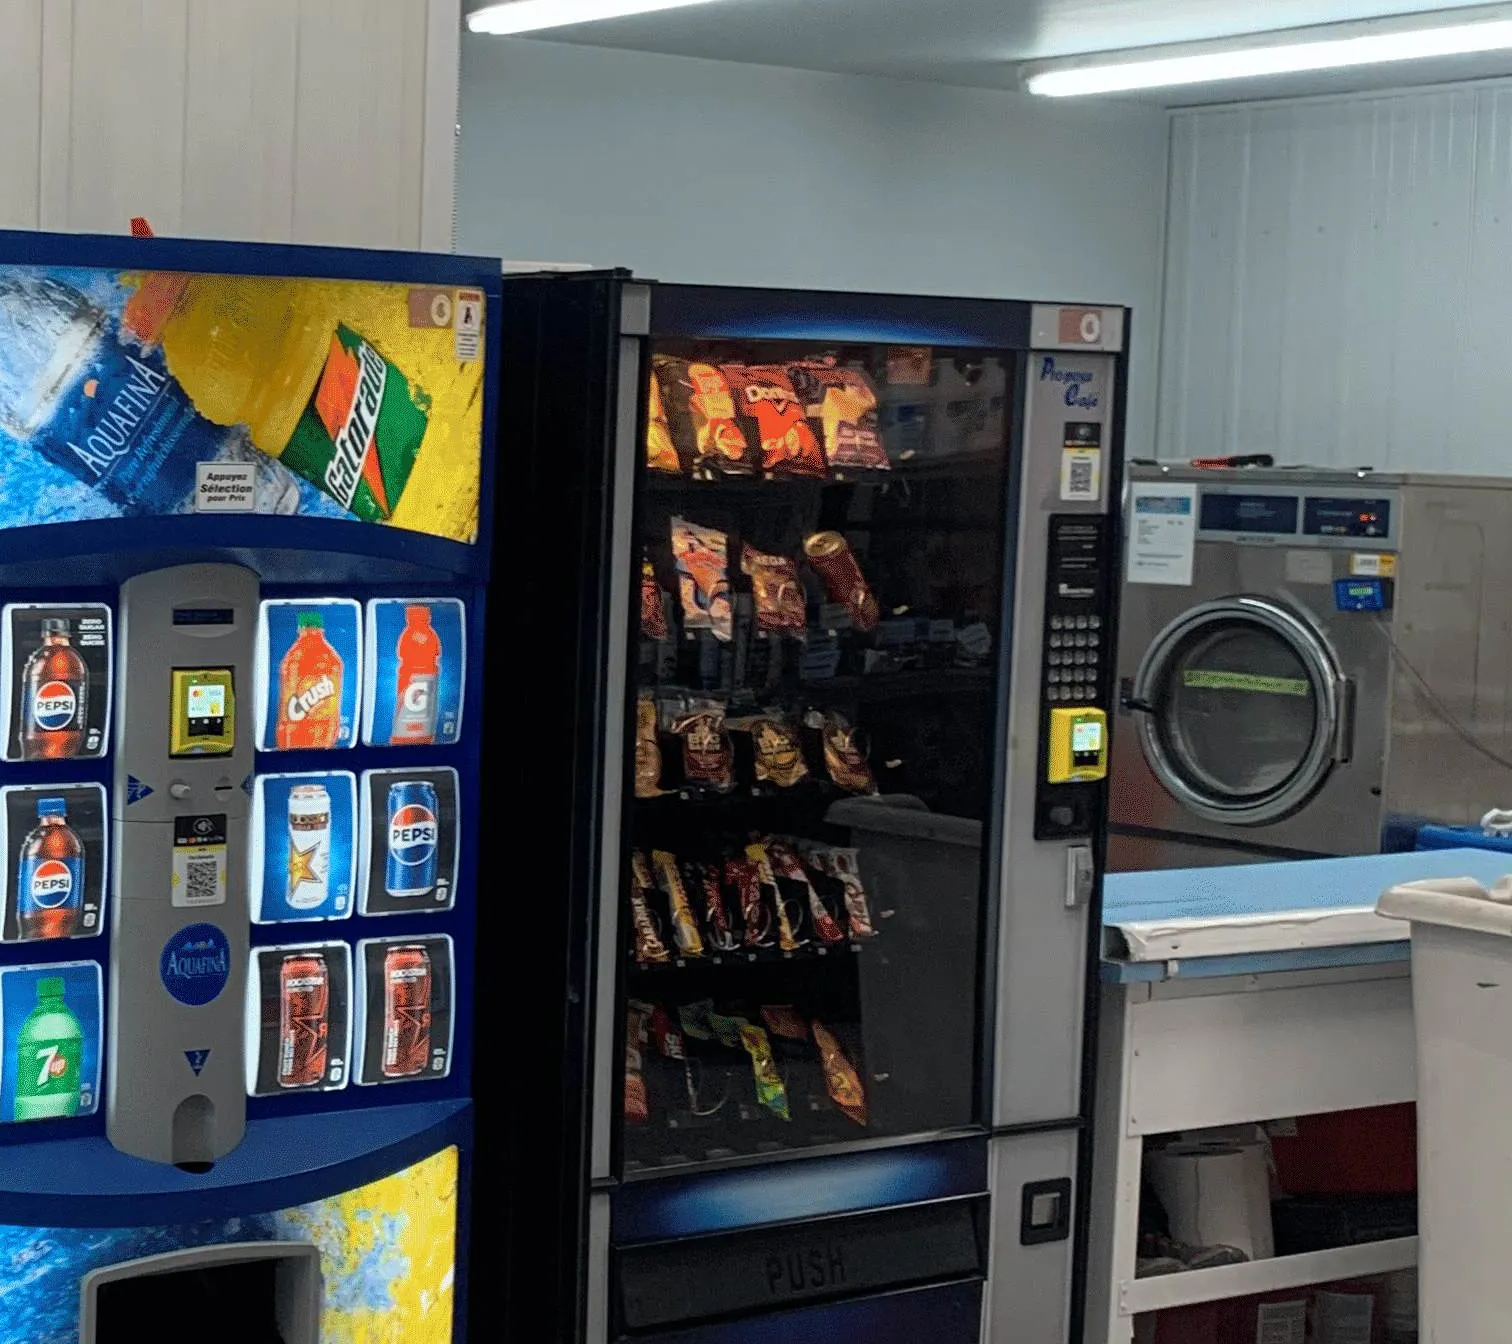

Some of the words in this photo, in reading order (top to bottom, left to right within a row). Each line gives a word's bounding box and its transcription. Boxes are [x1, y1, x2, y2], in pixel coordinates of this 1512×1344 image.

[66, 355, 165, 477] AQUAFINA
[326, 343, 386, 506] Gatorade
[200, 482, 252, 493] Sélection
[206, 472, 247, 482] Appuyez
[206, 495, 227, 503] pour
[229, 494, 245, 502] Prix
[38, 701, 73, 711] PEPSI
[288, 674, 335, 721] Crush
[404, 682, 428, 712] G
[392, 827, 435, 842] PEPSI
[34, 879, 70, 890] PEPSI
[167, 948, 226, 979] AQUAFINA
[767, 1249, 846, 1294] PUSH
